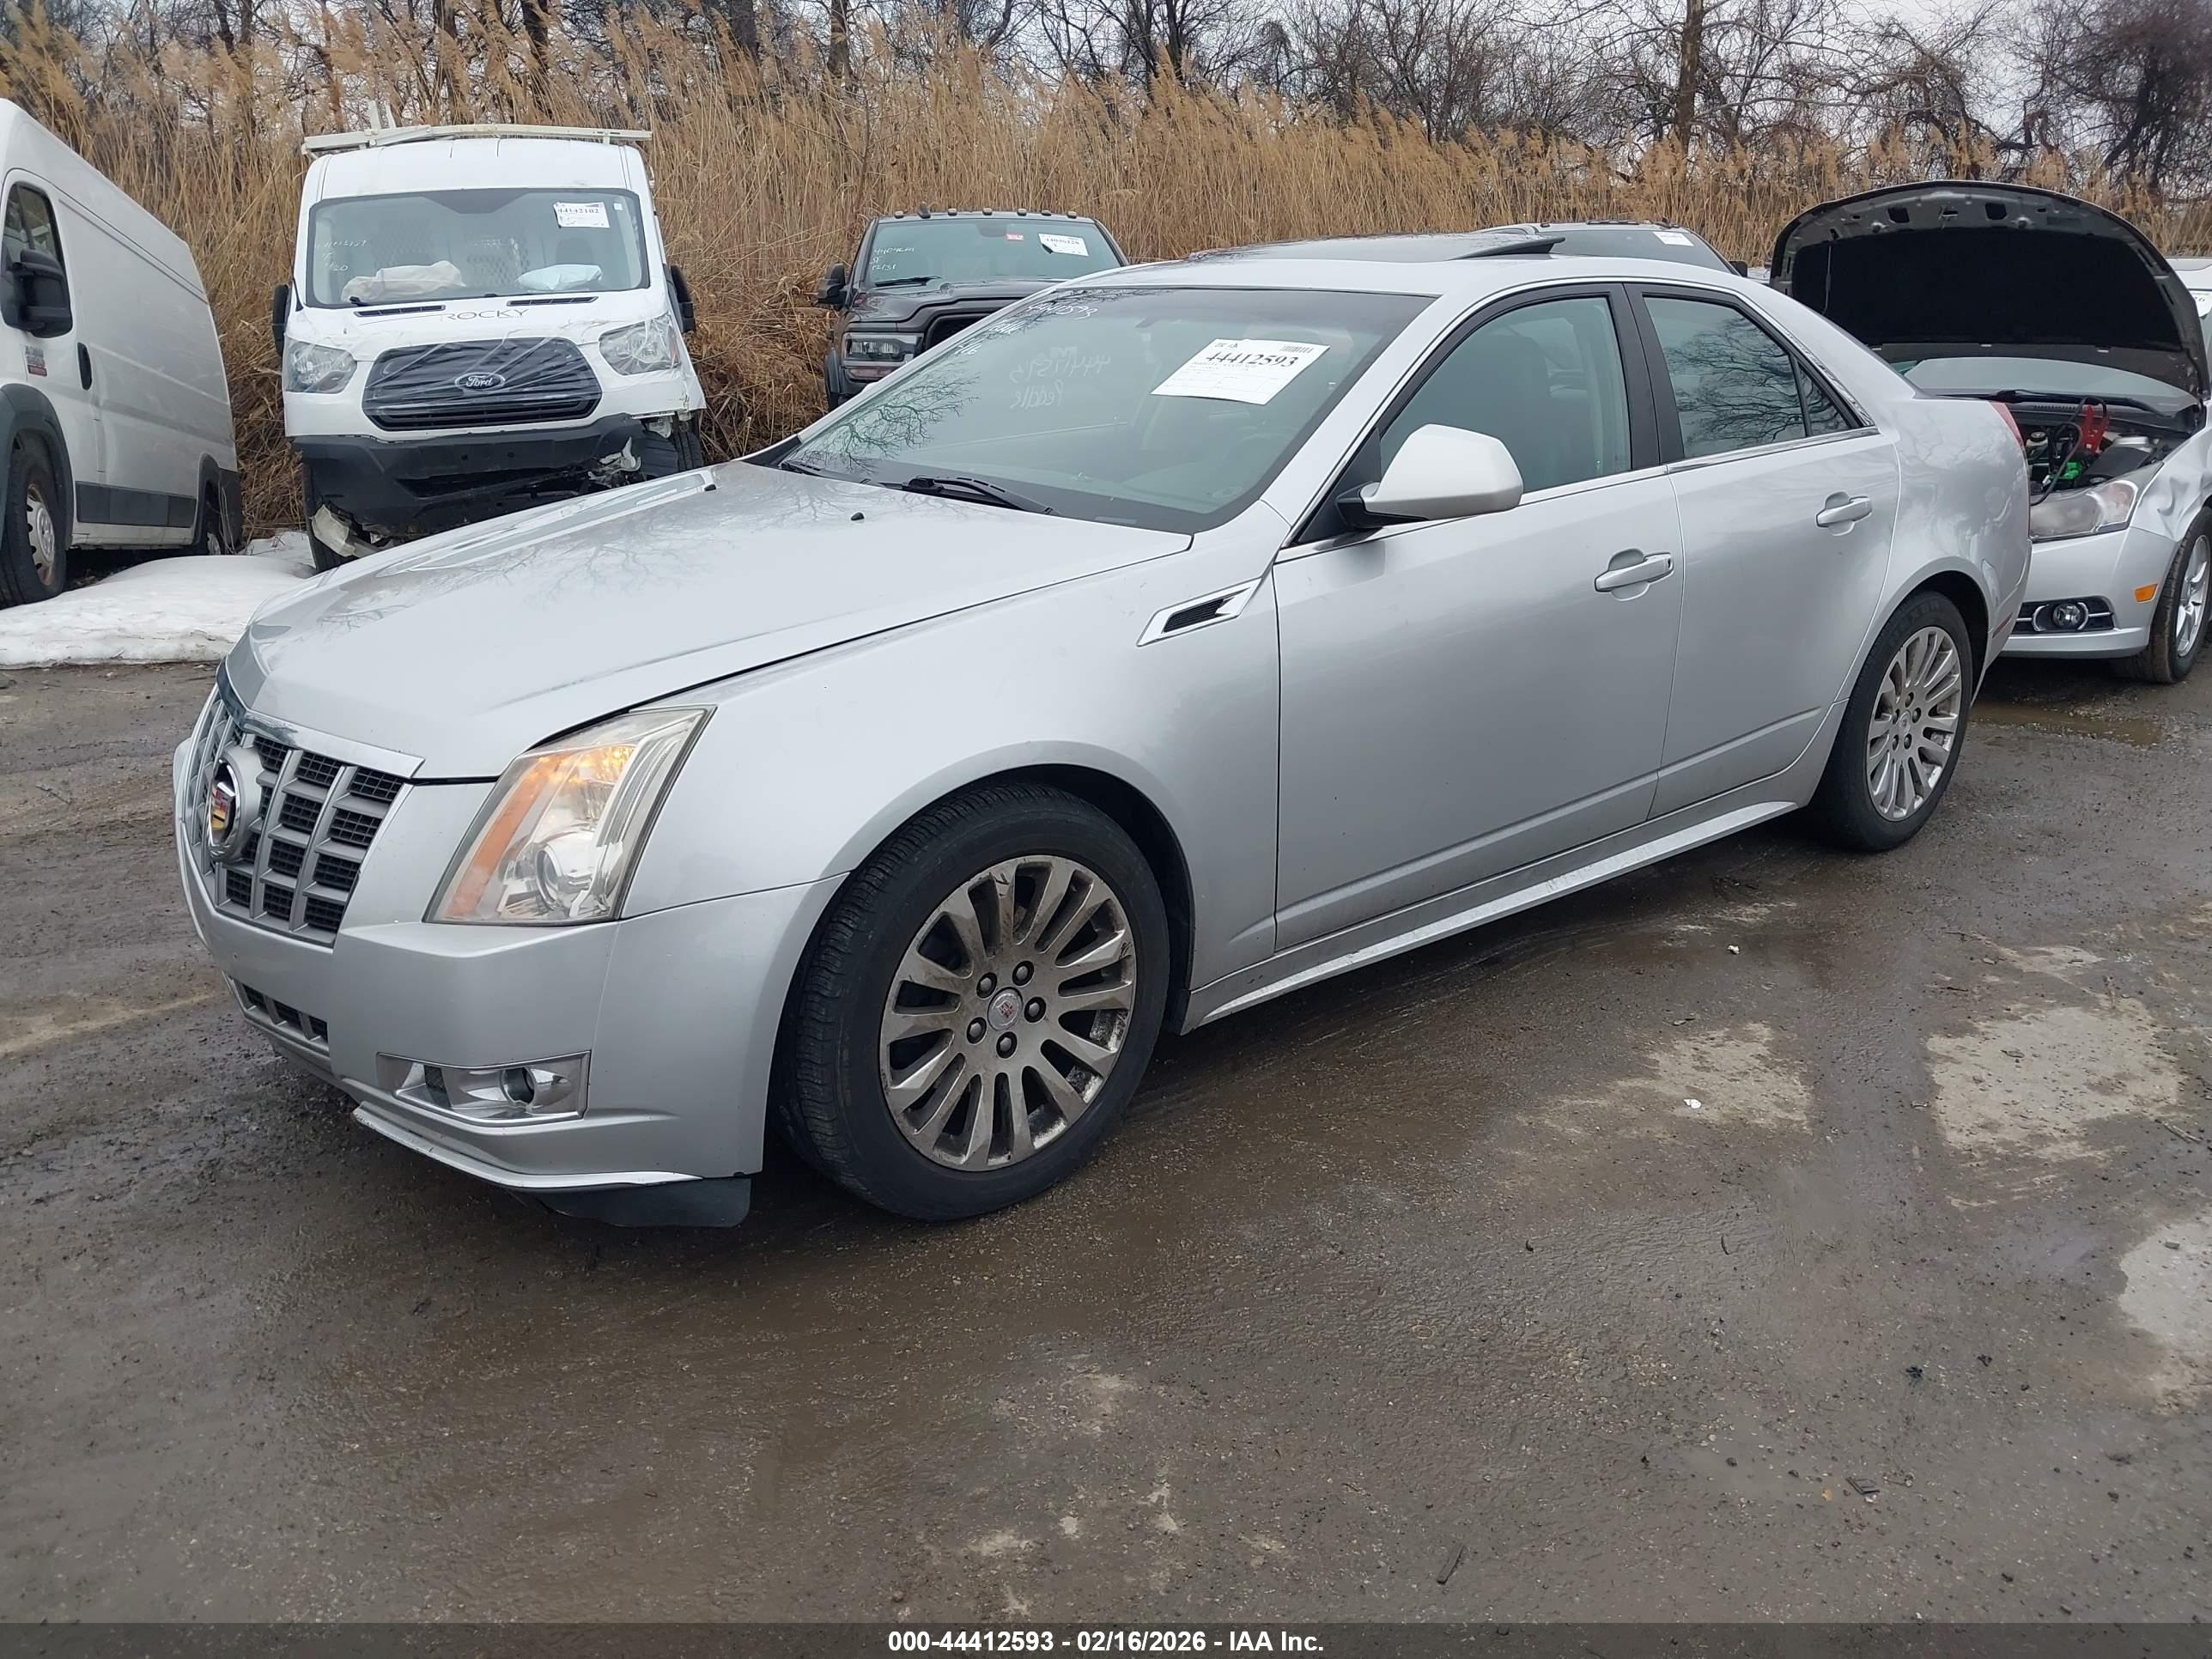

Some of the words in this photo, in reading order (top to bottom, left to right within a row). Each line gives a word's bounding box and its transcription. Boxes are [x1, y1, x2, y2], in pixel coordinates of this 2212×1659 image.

[441, 308, 529, 322] ROCKY
[1206, 351, 1299, 368] 44412593
[465, 375, 494, 387] Ford
